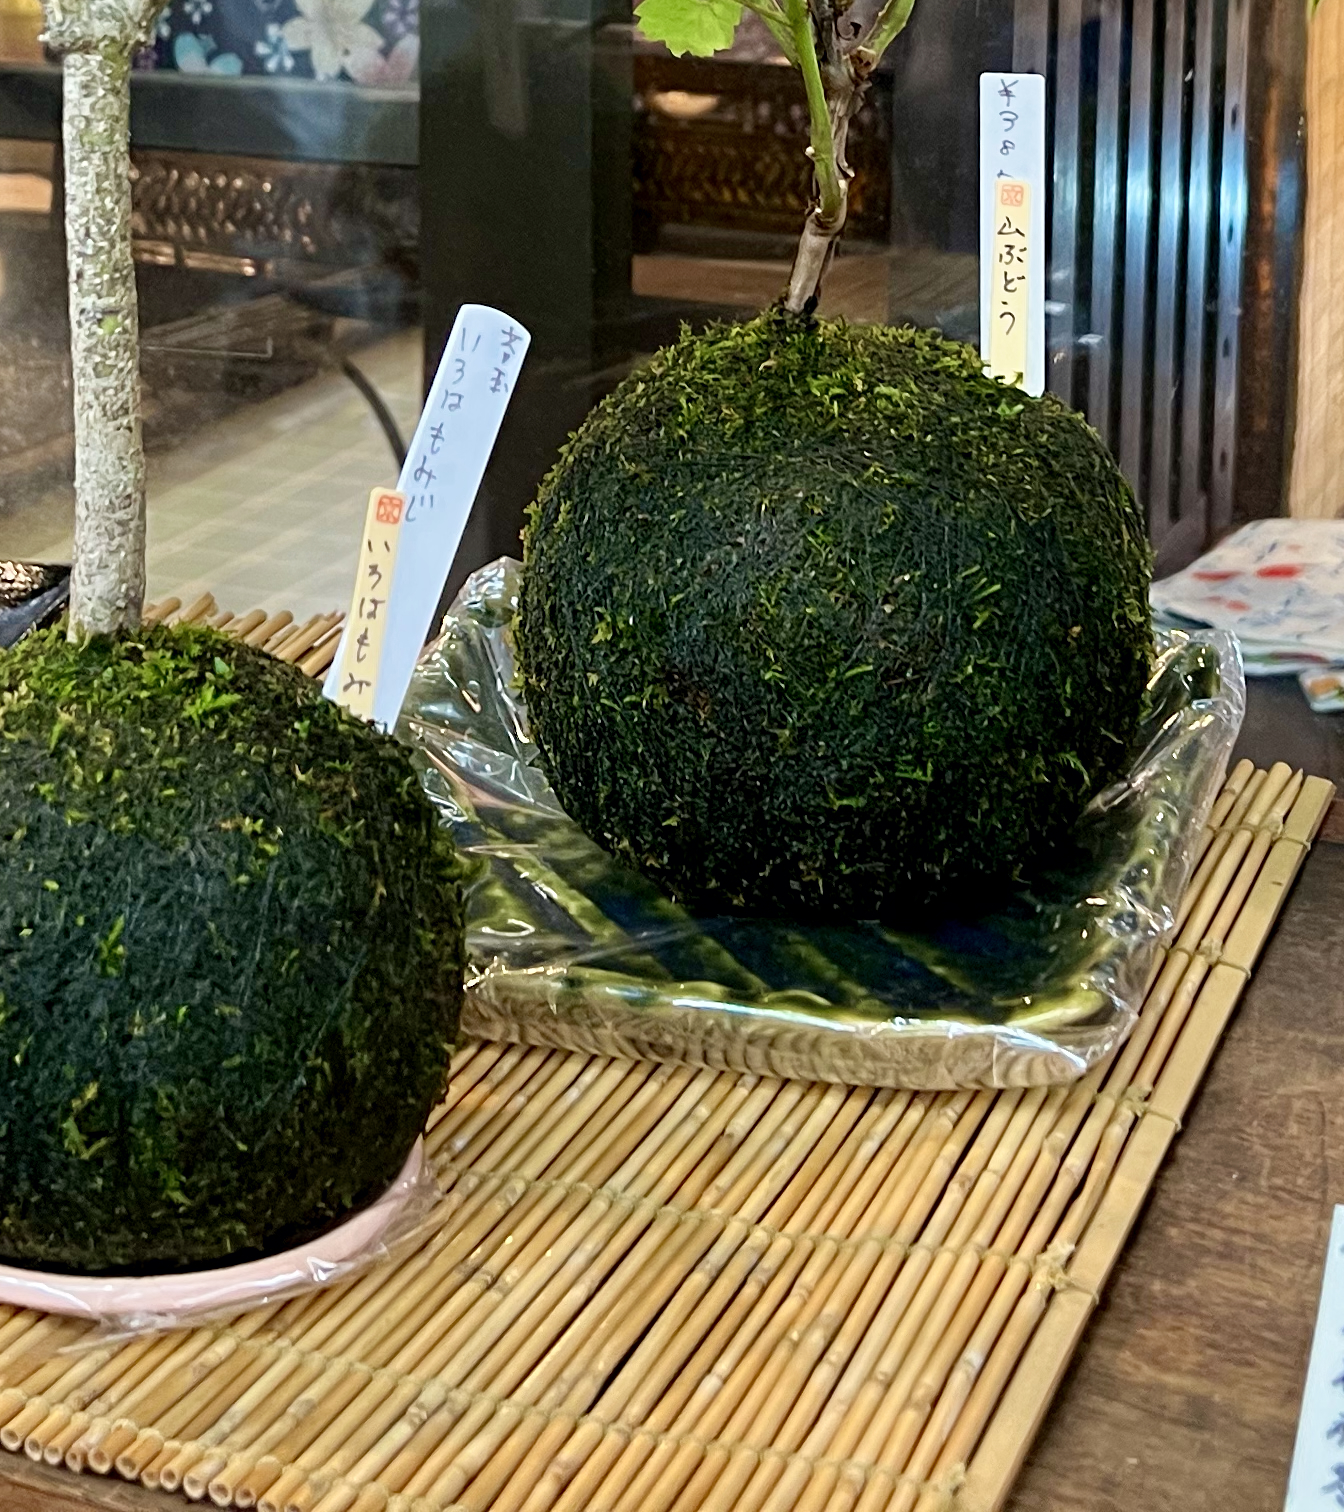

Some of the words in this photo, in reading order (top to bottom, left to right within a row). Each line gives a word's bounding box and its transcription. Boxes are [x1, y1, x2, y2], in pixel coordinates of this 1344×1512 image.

[405, 326, 482, 522] いろはもみじ
